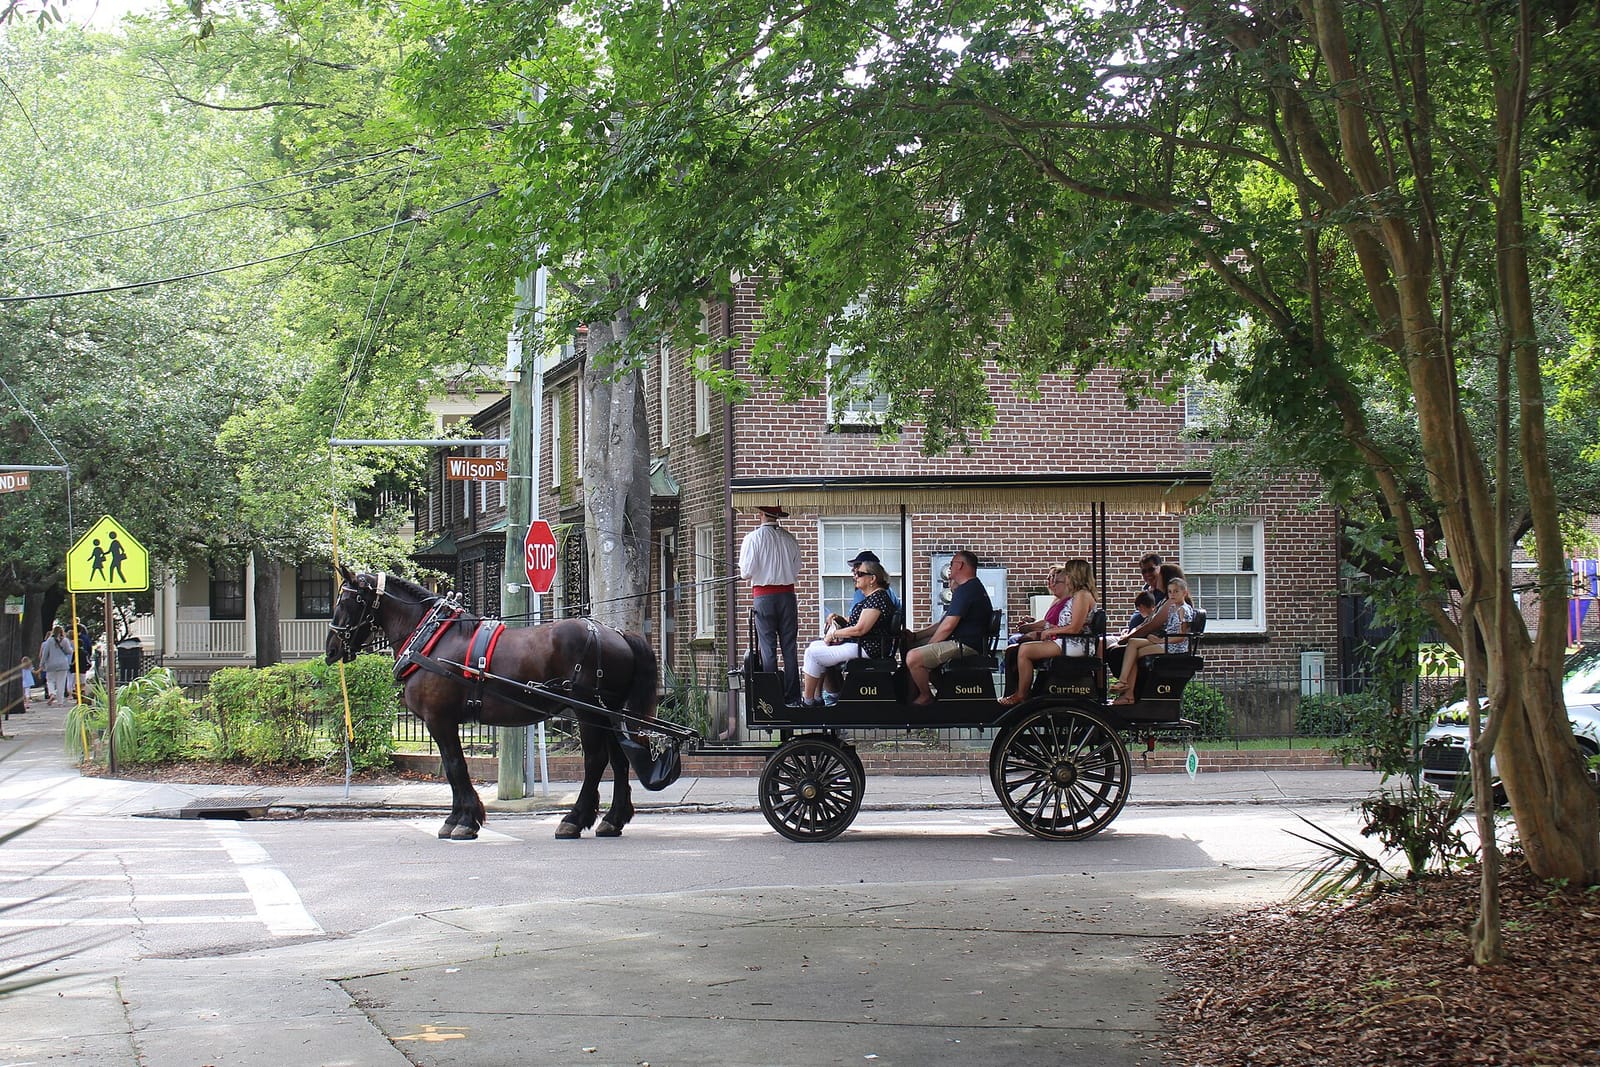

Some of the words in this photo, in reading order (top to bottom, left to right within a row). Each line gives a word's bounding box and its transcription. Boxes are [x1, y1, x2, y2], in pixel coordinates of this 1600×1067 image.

[450, 460, 495, 477] Wilson
[495, 460, 505, 472] St
[16, 476, 28, 486] LN
[527, 543, 555, 570] STOP
[860, 686, 877, 696] Old
[955, 685, 983, 694] South
[1048, 685, 1091, 695] Carriage
